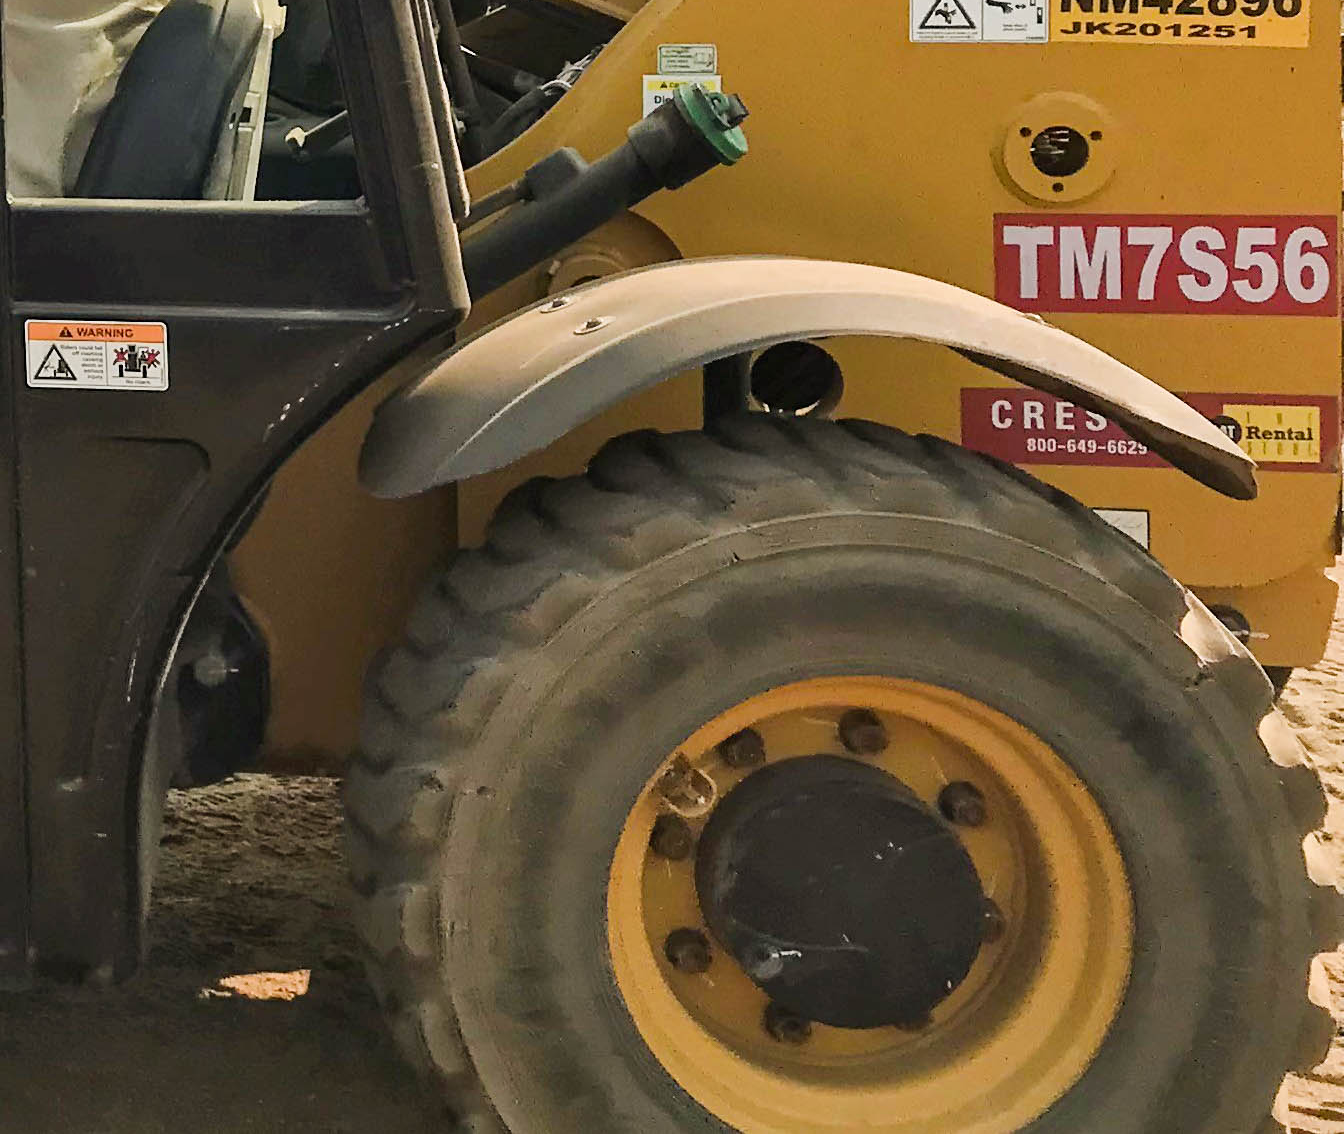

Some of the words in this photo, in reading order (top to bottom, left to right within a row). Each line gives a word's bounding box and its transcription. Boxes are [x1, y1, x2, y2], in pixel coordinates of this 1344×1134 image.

[1059, 21, 1257, 39] JK201251
[1002, 225, 1330, 304] TM7S56
[76, 327, 134, 338] WARNING
[991, 399, 1108, 432] CRES
[1246, 425, 1314, 441] Rental
